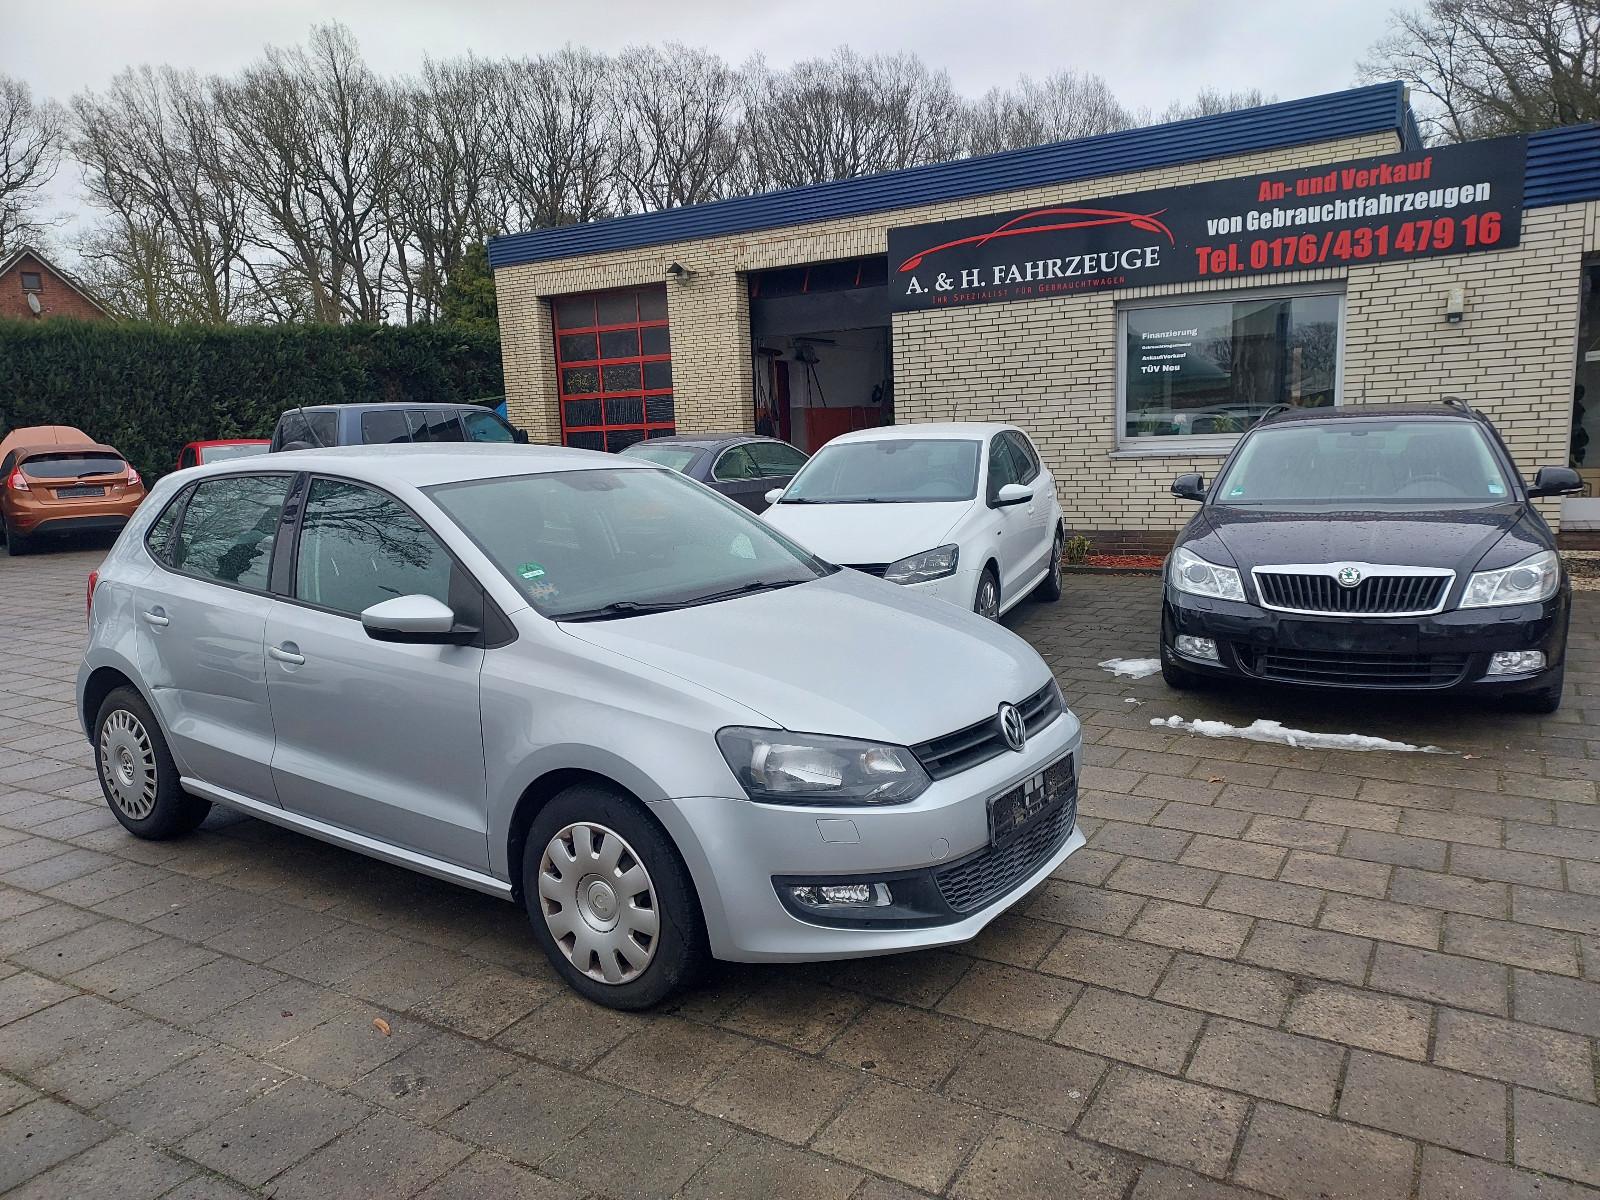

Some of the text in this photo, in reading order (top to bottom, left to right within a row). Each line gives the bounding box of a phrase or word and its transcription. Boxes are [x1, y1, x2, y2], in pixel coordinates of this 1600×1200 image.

[1258, 157, 1432, 202] An- und Verkauf
[1207, 182, 1491, 236] von Gebrauchtfahrzeugen
[1195, 211, 1502, 275] Tel. 0176/431 479 16
[905, 245, 1161, 295] A. & H. FAHRZEUGE
[1142, 328, 1198, 340] Finanzierung
[1141, 364, 1181, 374] TÜV Neu
